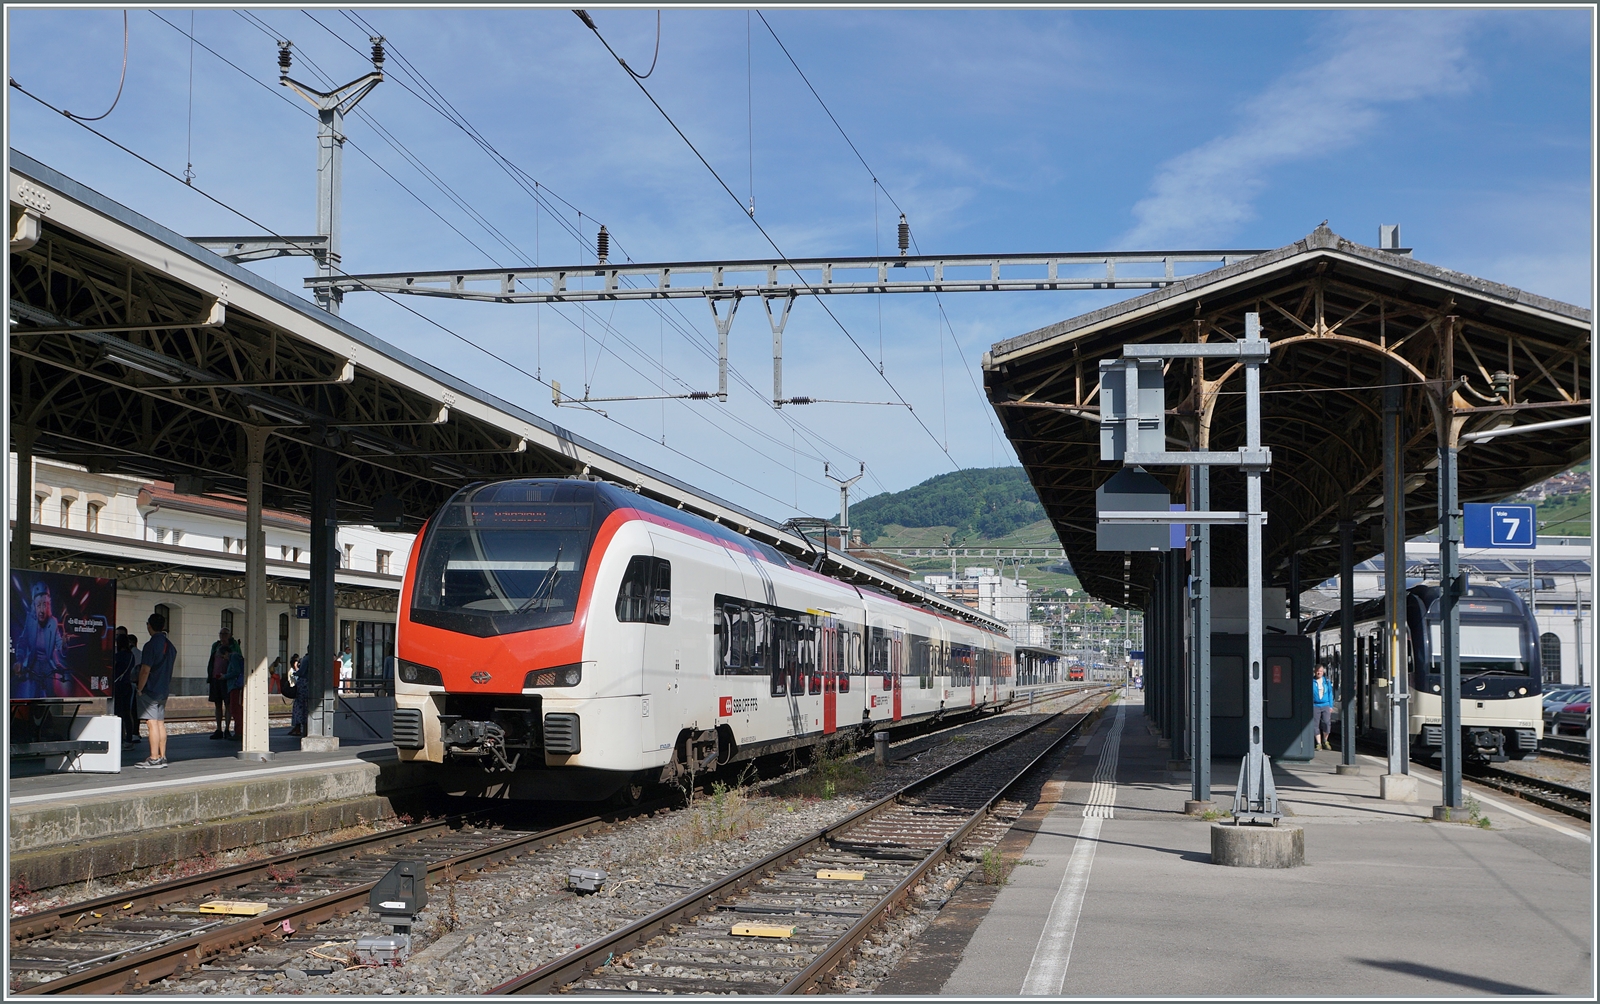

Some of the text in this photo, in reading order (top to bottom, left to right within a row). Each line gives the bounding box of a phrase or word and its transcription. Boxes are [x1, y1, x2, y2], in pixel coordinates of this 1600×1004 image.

[1502, 518, 1520, 540] 7
[733, 698, 741, 713] SBB
[750, 698, 758, 711] FFS
